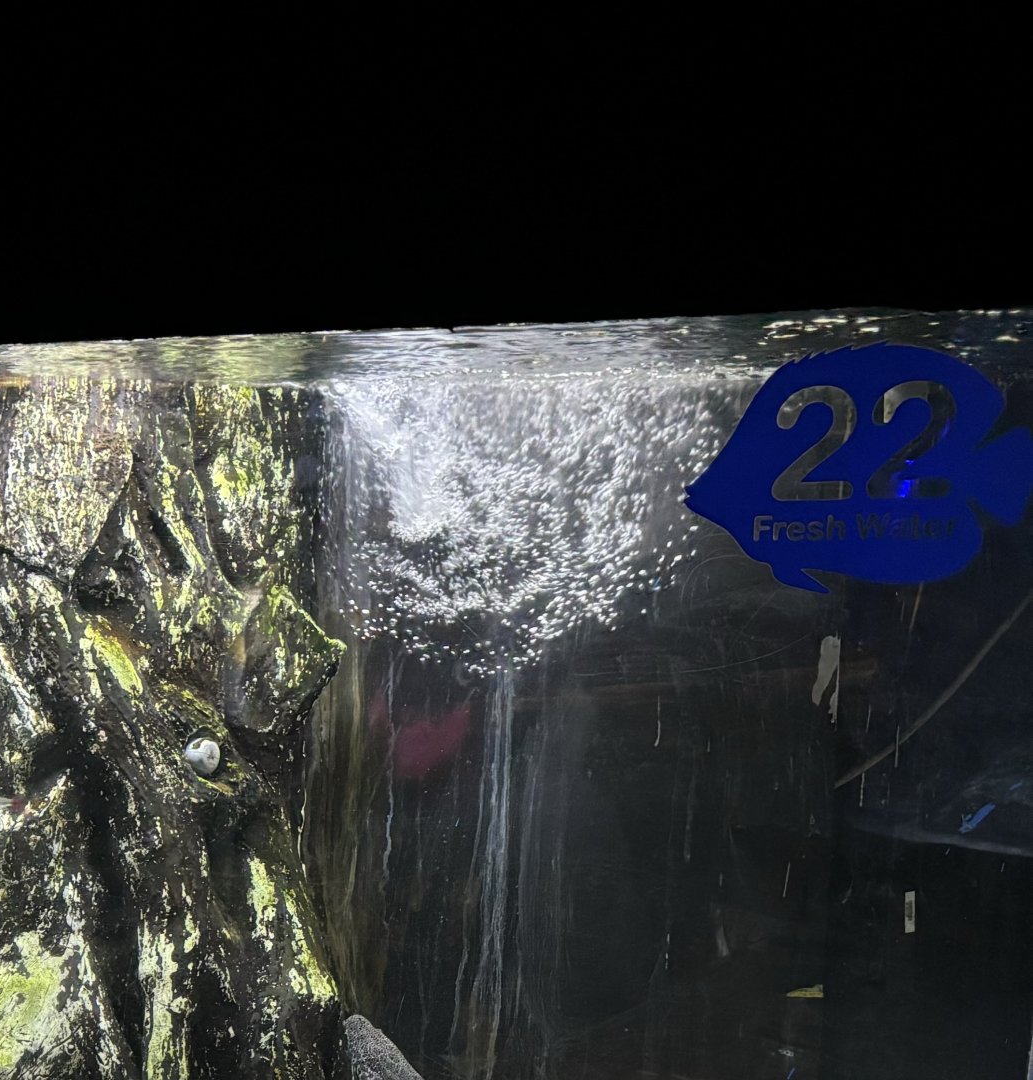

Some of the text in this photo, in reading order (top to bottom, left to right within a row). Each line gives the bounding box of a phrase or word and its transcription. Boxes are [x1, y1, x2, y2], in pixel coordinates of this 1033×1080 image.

[771, 380, 956, 501] 22
[753, 512, 956, 541] Fresh Water
